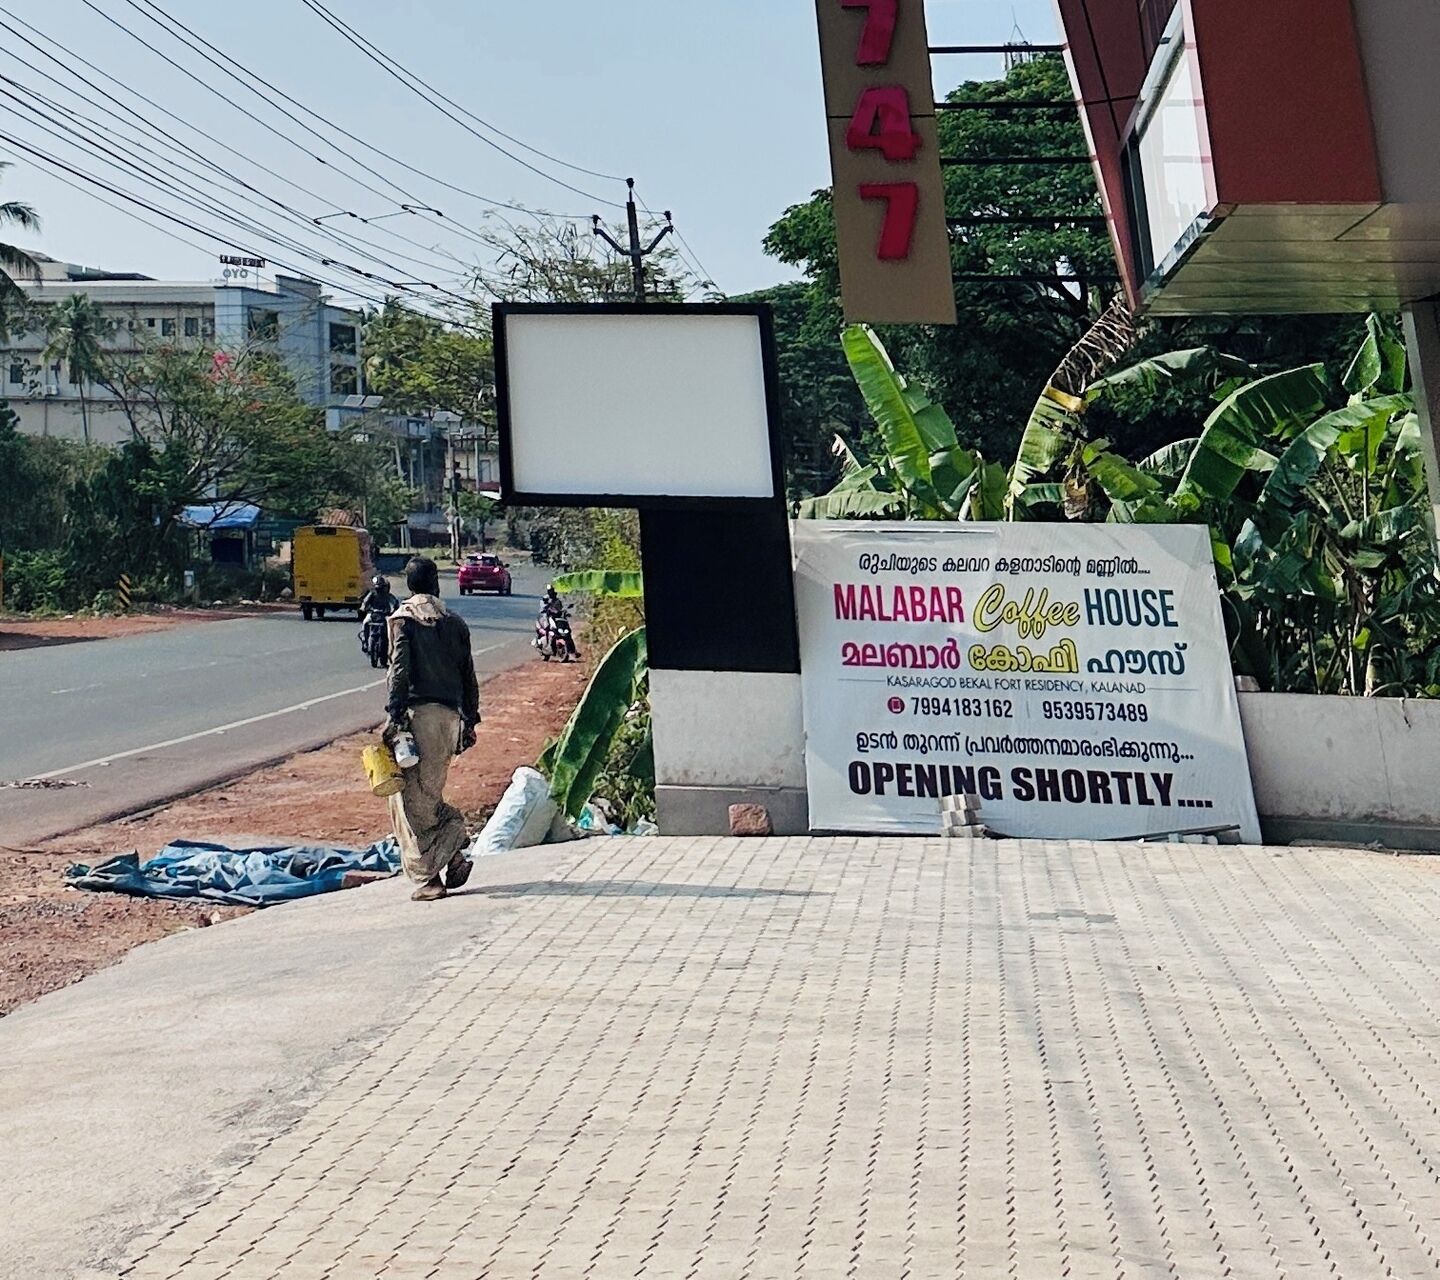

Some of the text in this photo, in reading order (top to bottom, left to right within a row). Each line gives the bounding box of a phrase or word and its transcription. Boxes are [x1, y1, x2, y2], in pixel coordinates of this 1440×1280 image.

[942, 557, 990, 572] കലവറ
[834, 583, 1179, 639] MALABAR Coffee HOUSE
[841, 638, 960, 669] മലബാർ
[968, 638, 1079, 673] കോഫി
[887, 675, 956, 688] KASARAGOD
[960, 677, 992, 690] BEKAL
[994, 678, 1021, 690] FORT
[1091, 680, 1146, 694] KALANAD
[910, 697, 1148, 722] 7994183162 9539573489
[856, 730, 898, 753] ഉടൻ
[848, 761, 1003, 801] OPENING
